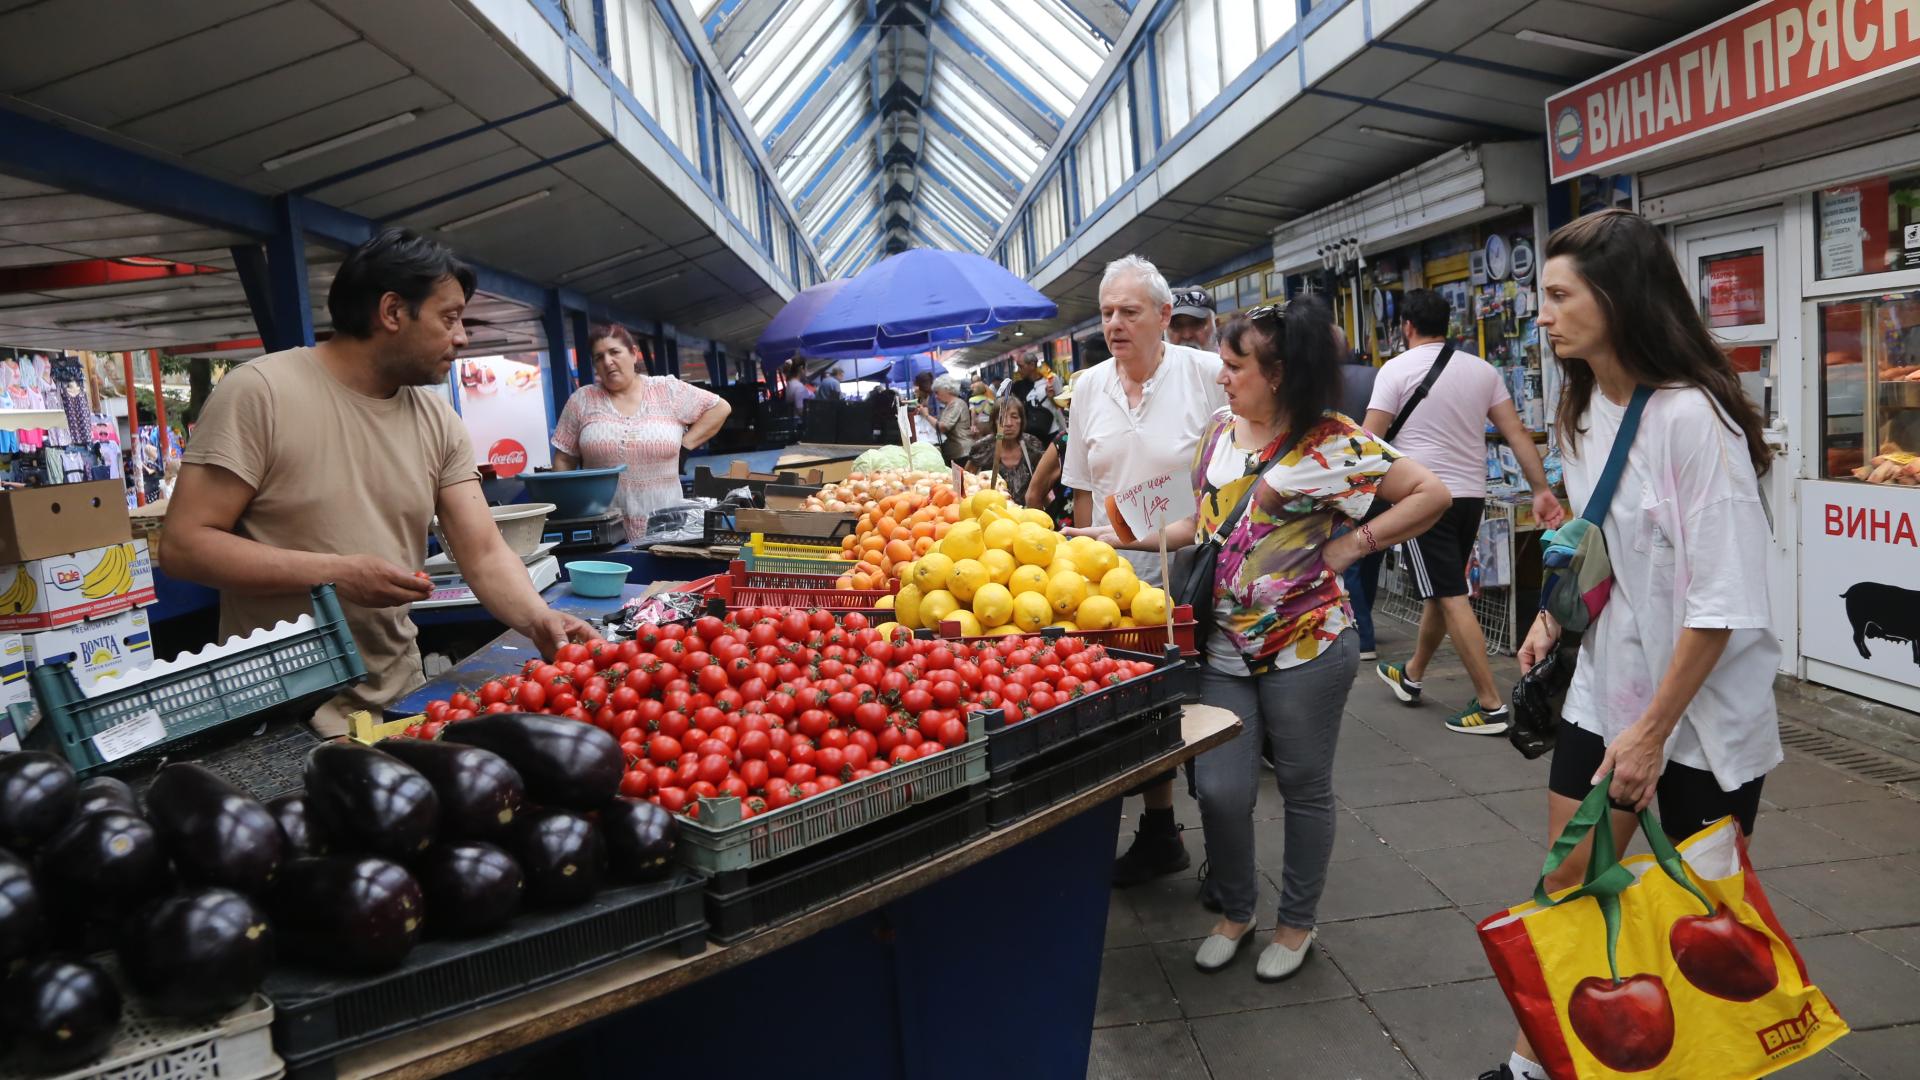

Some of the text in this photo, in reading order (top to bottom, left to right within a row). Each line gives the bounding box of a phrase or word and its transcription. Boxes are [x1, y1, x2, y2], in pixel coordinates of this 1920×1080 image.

[1587, 38, 1730, 155] ВИНАГИ
[1743, 0, 1920, 99] ПРЯСН
[491, 450, 524, 465] Coca-Cola
[1825, 504, 1918, 548] ВИНА
[57, 570, 80, 584] Dole
[71, 618, 120, 635] PREMIUM PACK
[80, 634, 121, 665] BONITA
[1760, 1005, 1817, 1053] BILLA
